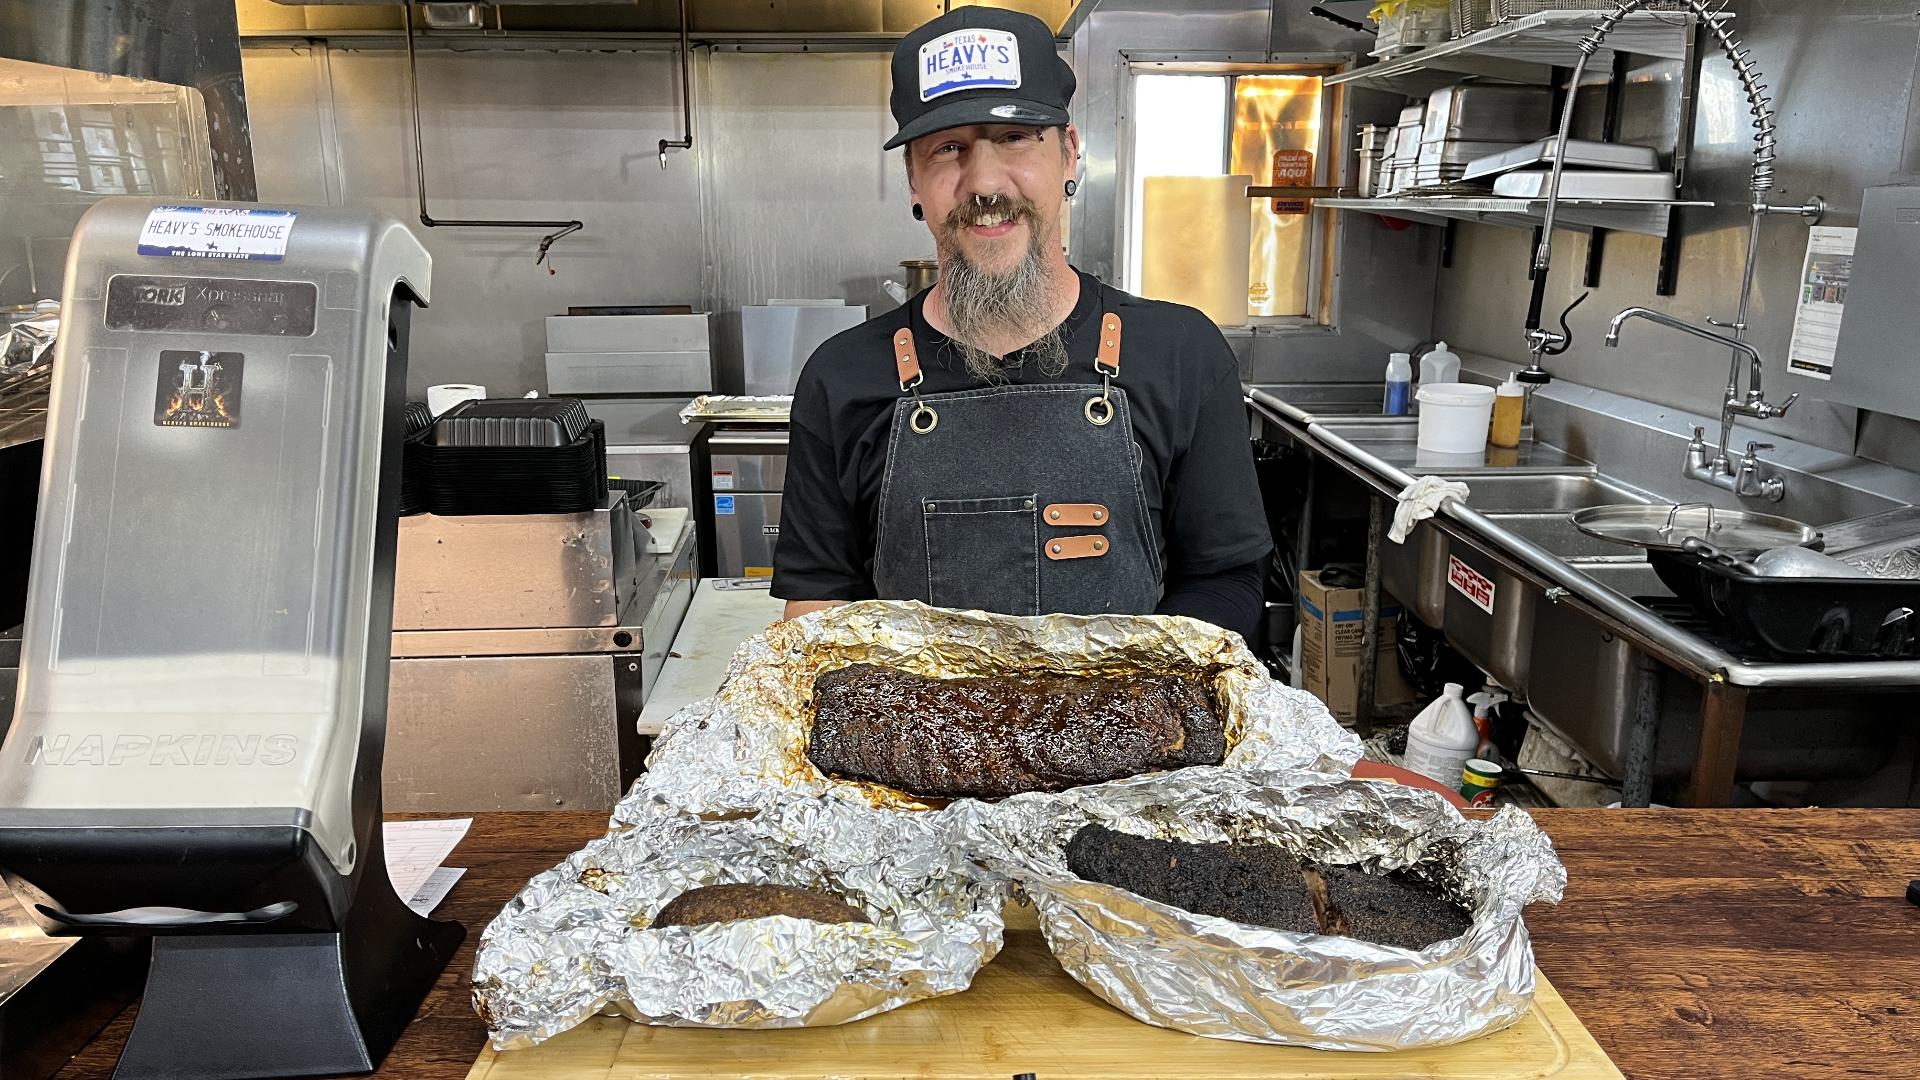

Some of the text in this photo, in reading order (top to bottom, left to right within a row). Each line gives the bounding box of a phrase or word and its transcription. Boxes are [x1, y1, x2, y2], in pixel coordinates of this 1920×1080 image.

[954, 34, 976, 46] TEXAS
[927, 44, 1010, 75] HEAVY'S
[945, 63, 988, 74] SMOKEHOUSE
[148, 220, 286, 240] HEAVY'S SMOKEHOUSE
[24, 733, 298, 766] NAPKINS
